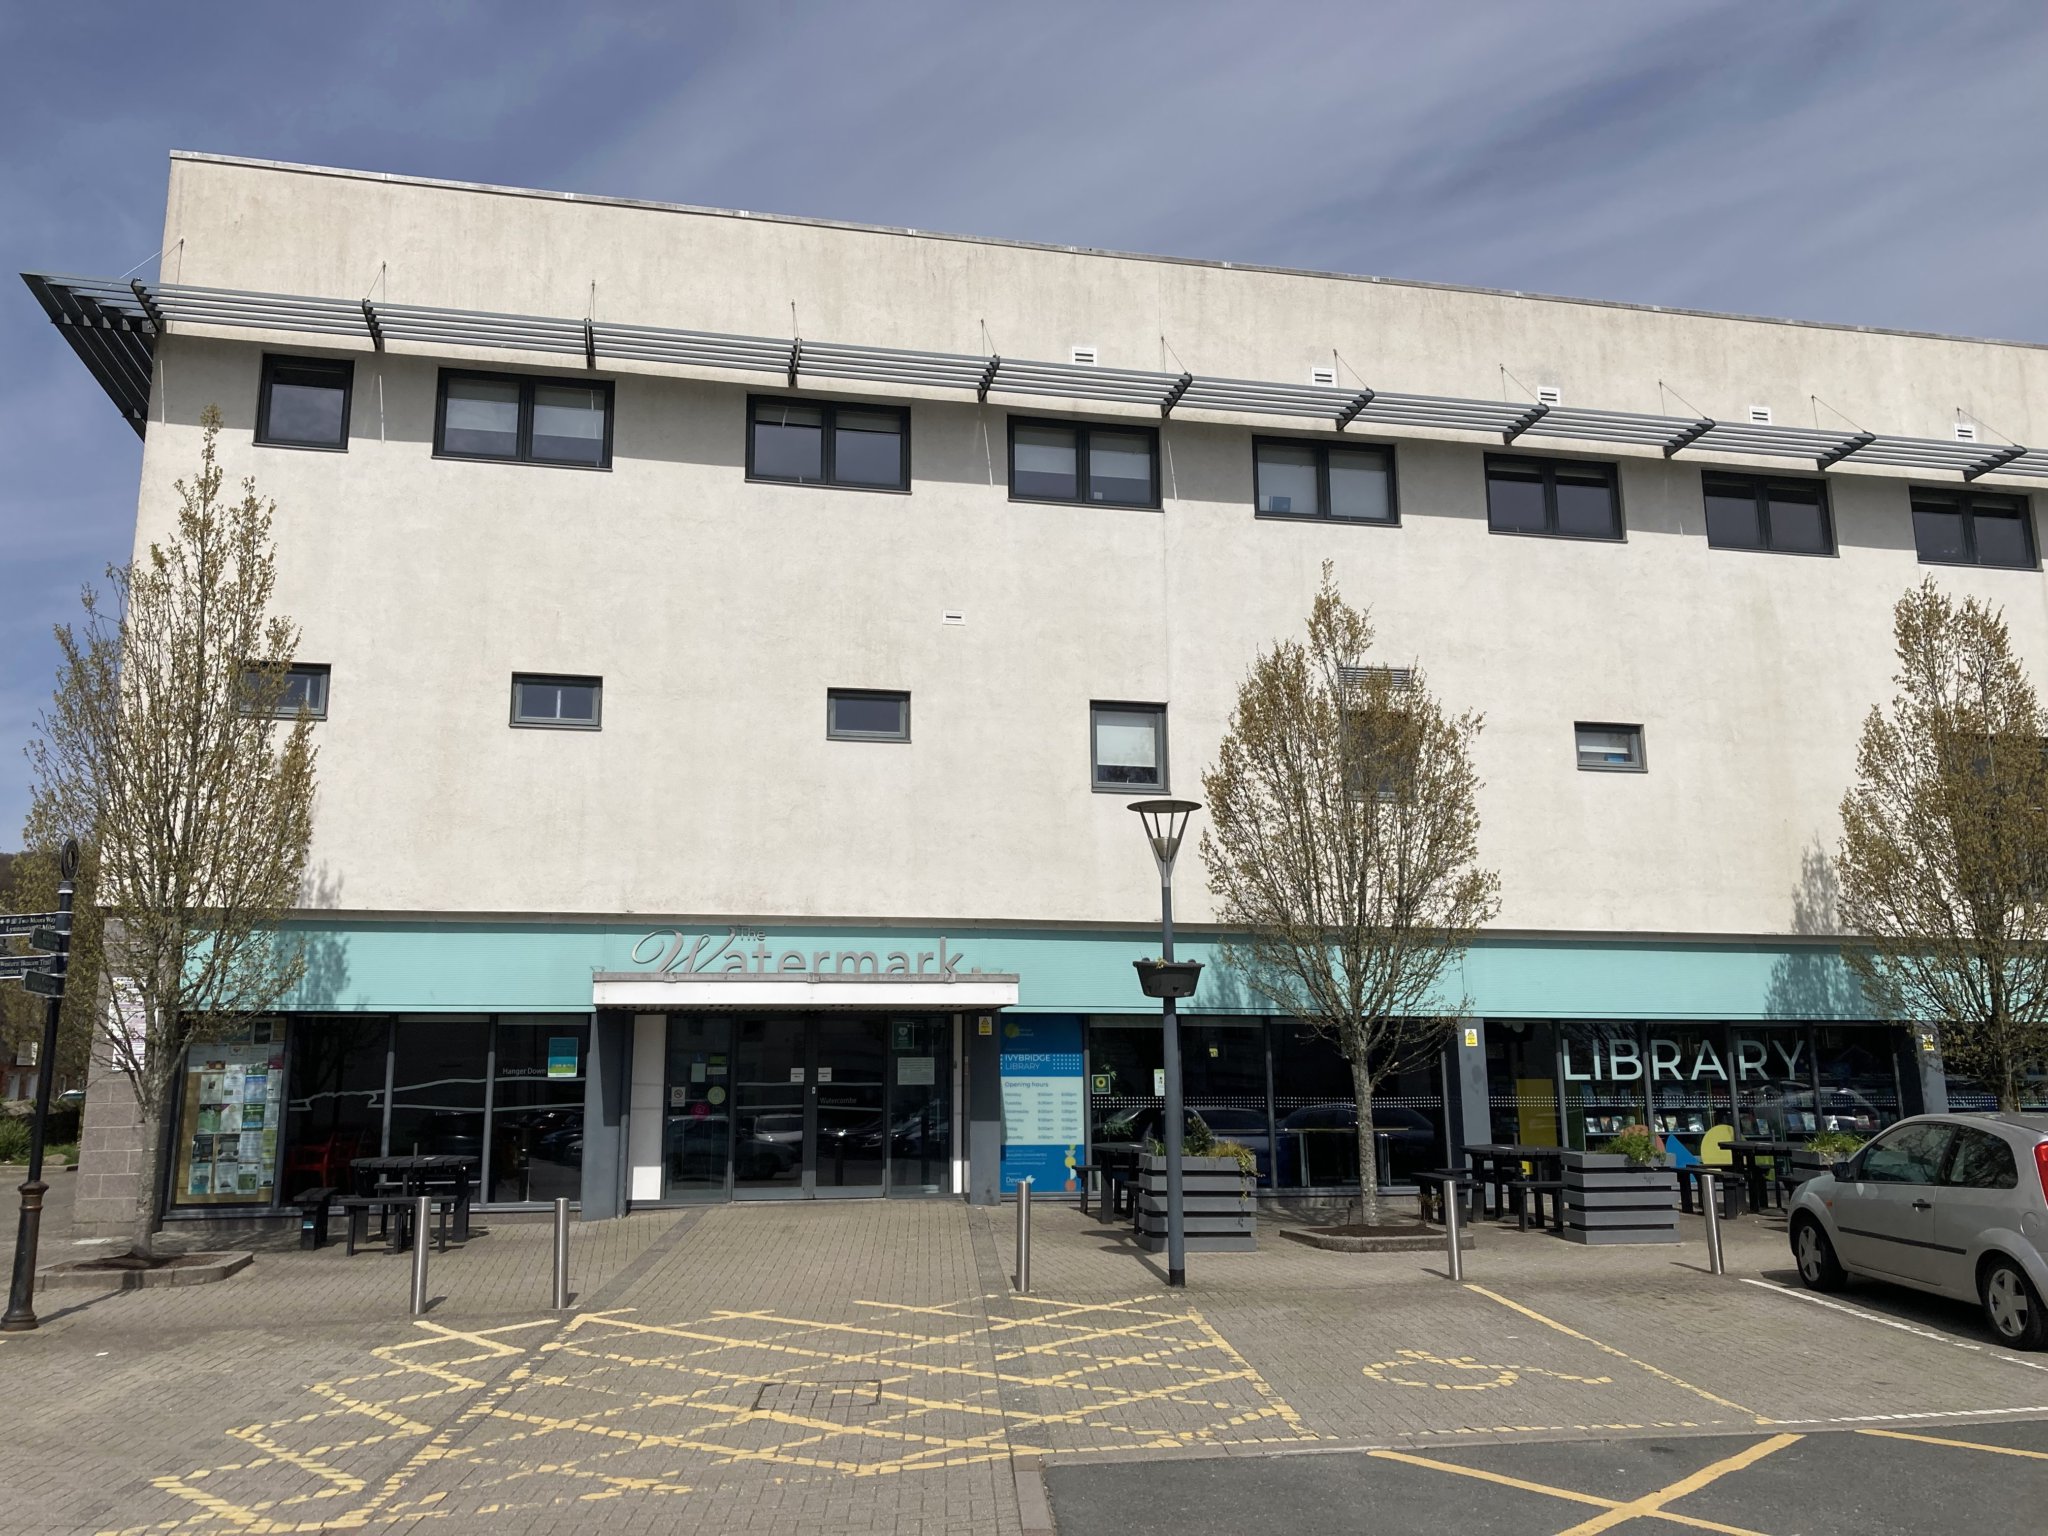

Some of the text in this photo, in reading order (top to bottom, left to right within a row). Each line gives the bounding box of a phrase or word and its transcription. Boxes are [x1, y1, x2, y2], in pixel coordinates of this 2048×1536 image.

[737, 926, 766, 942] The
[631, 928, 964, 974] Watermark
[1005, 1054, 1051, 1062] IVYBRIDGE
[1562, 1039, 1805, 1081] LIBRARY
[502, 1067, 526, 1076] Hanger
[527, 1067, 546, 1075] Down
[1005, 1062, 1040, 1070] LIBRARY
